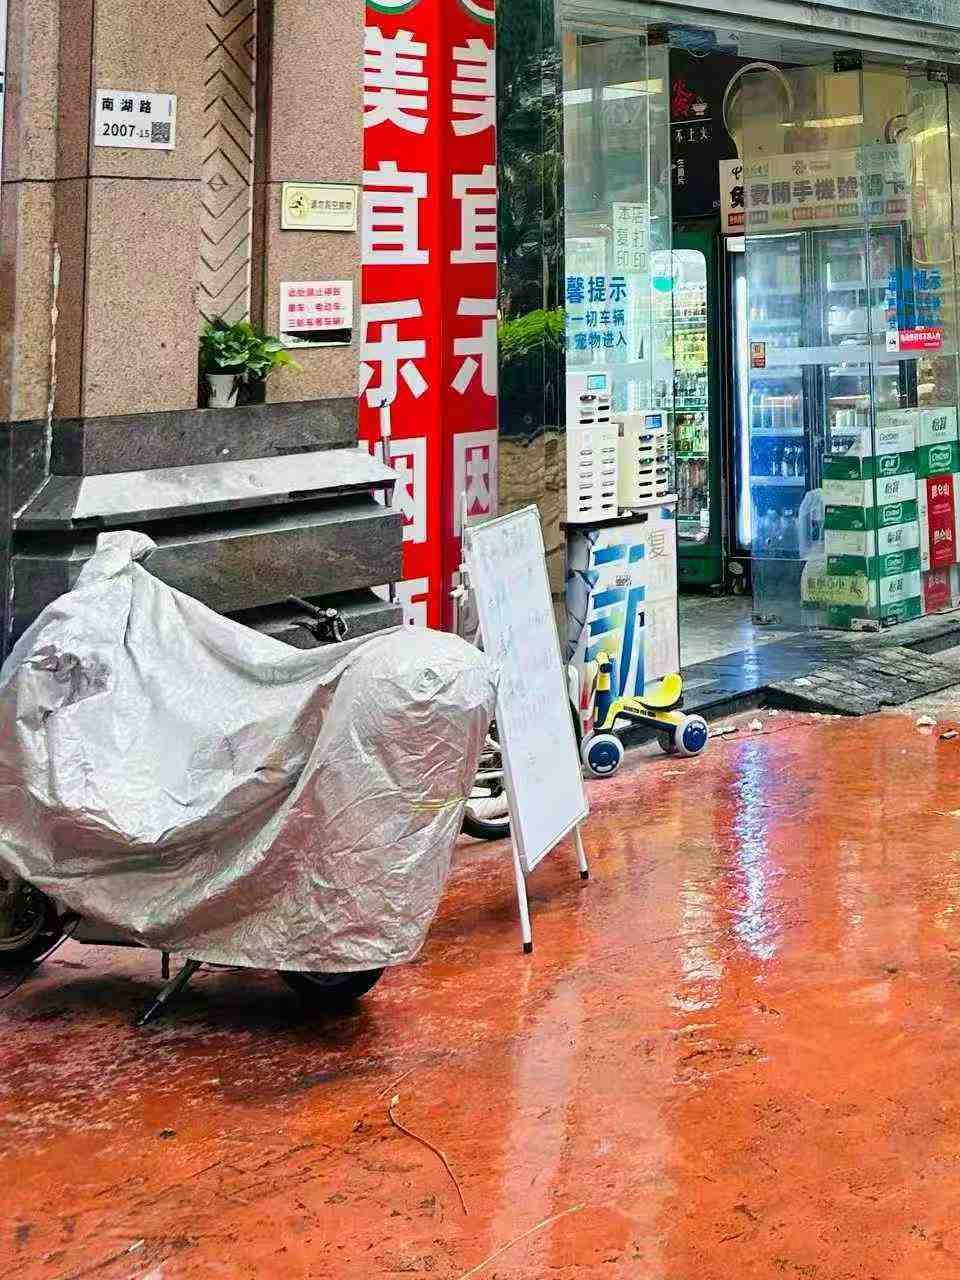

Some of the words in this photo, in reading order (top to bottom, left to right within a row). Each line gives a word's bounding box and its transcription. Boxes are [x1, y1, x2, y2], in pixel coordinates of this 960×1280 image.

[102, 97, 151, 114] 南湖路
[567, 275, 627, 304] 馨提示
[567, 309, 625, 328] 一切车辆
